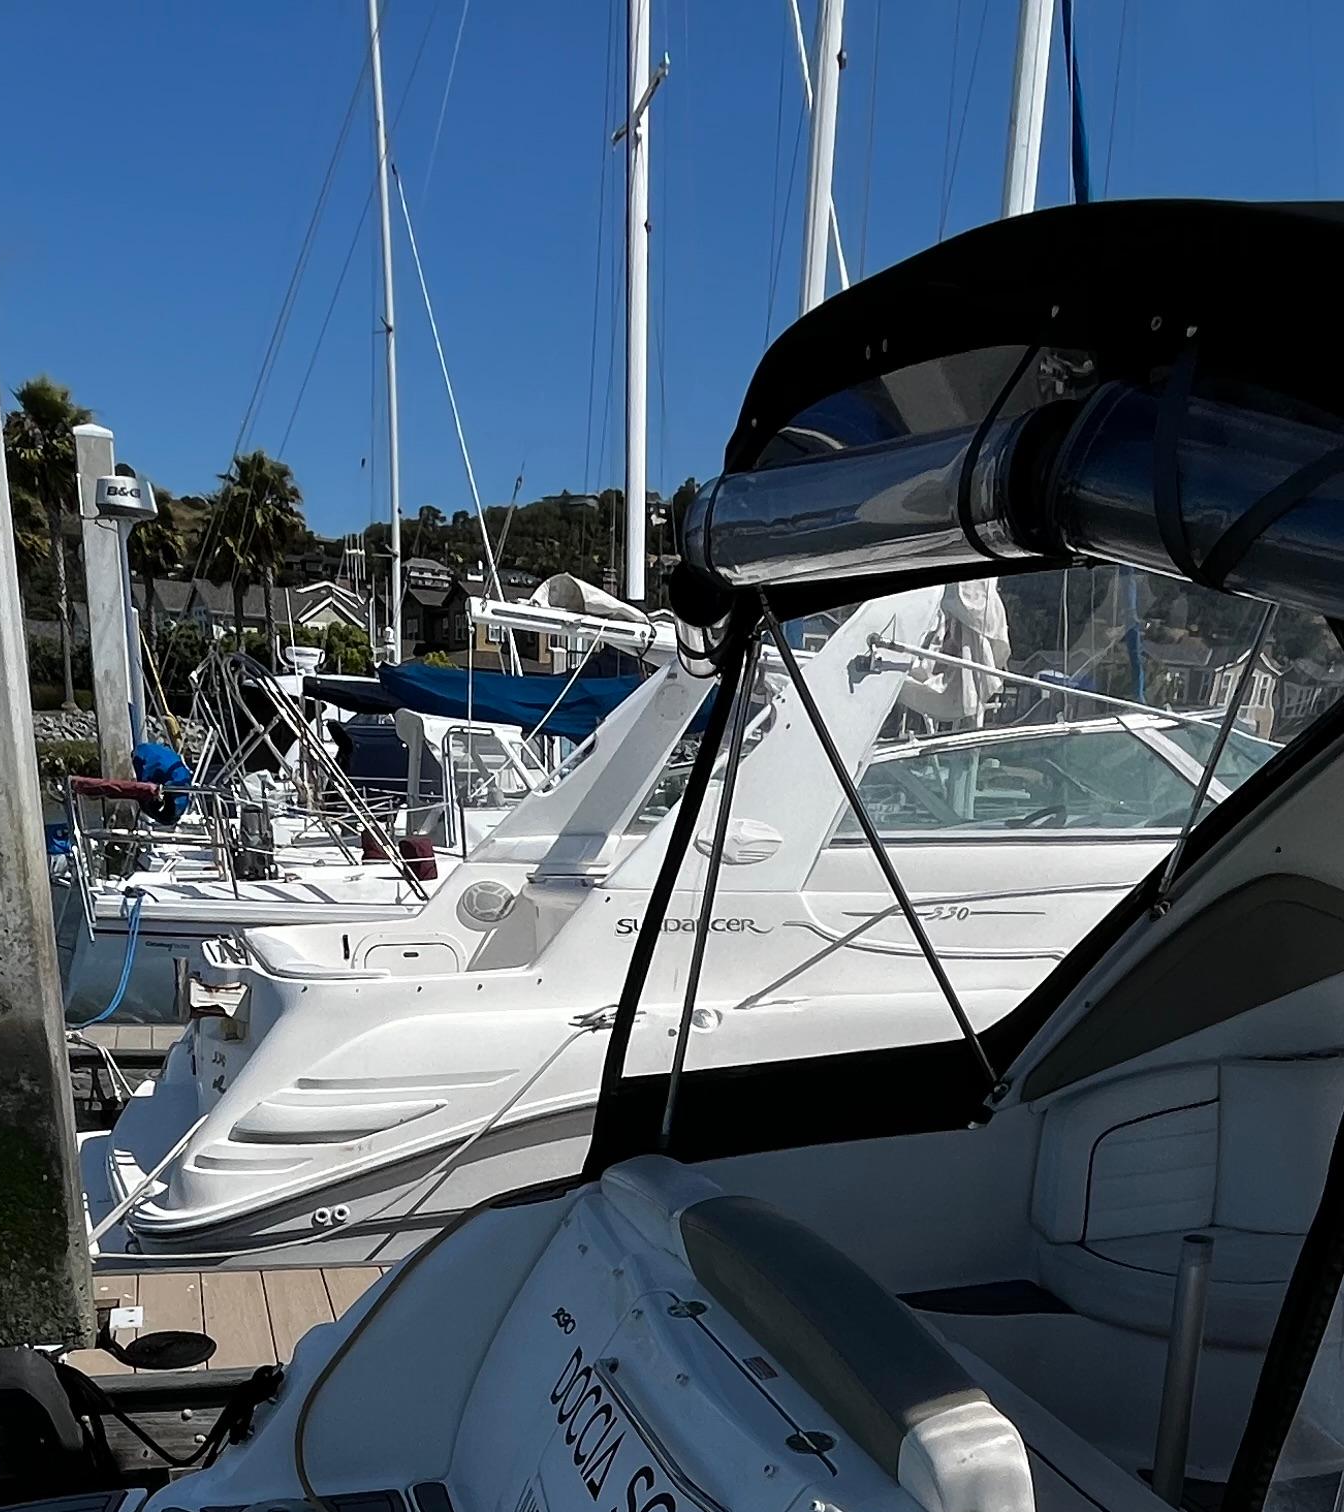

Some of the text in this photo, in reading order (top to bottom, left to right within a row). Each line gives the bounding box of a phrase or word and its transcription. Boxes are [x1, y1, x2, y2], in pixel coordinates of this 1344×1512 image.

[107, 486, 141, 499] B&G
[616, 917, 775, 936] SDACER
[550, 1345, 627, 1502] DOCCIA
